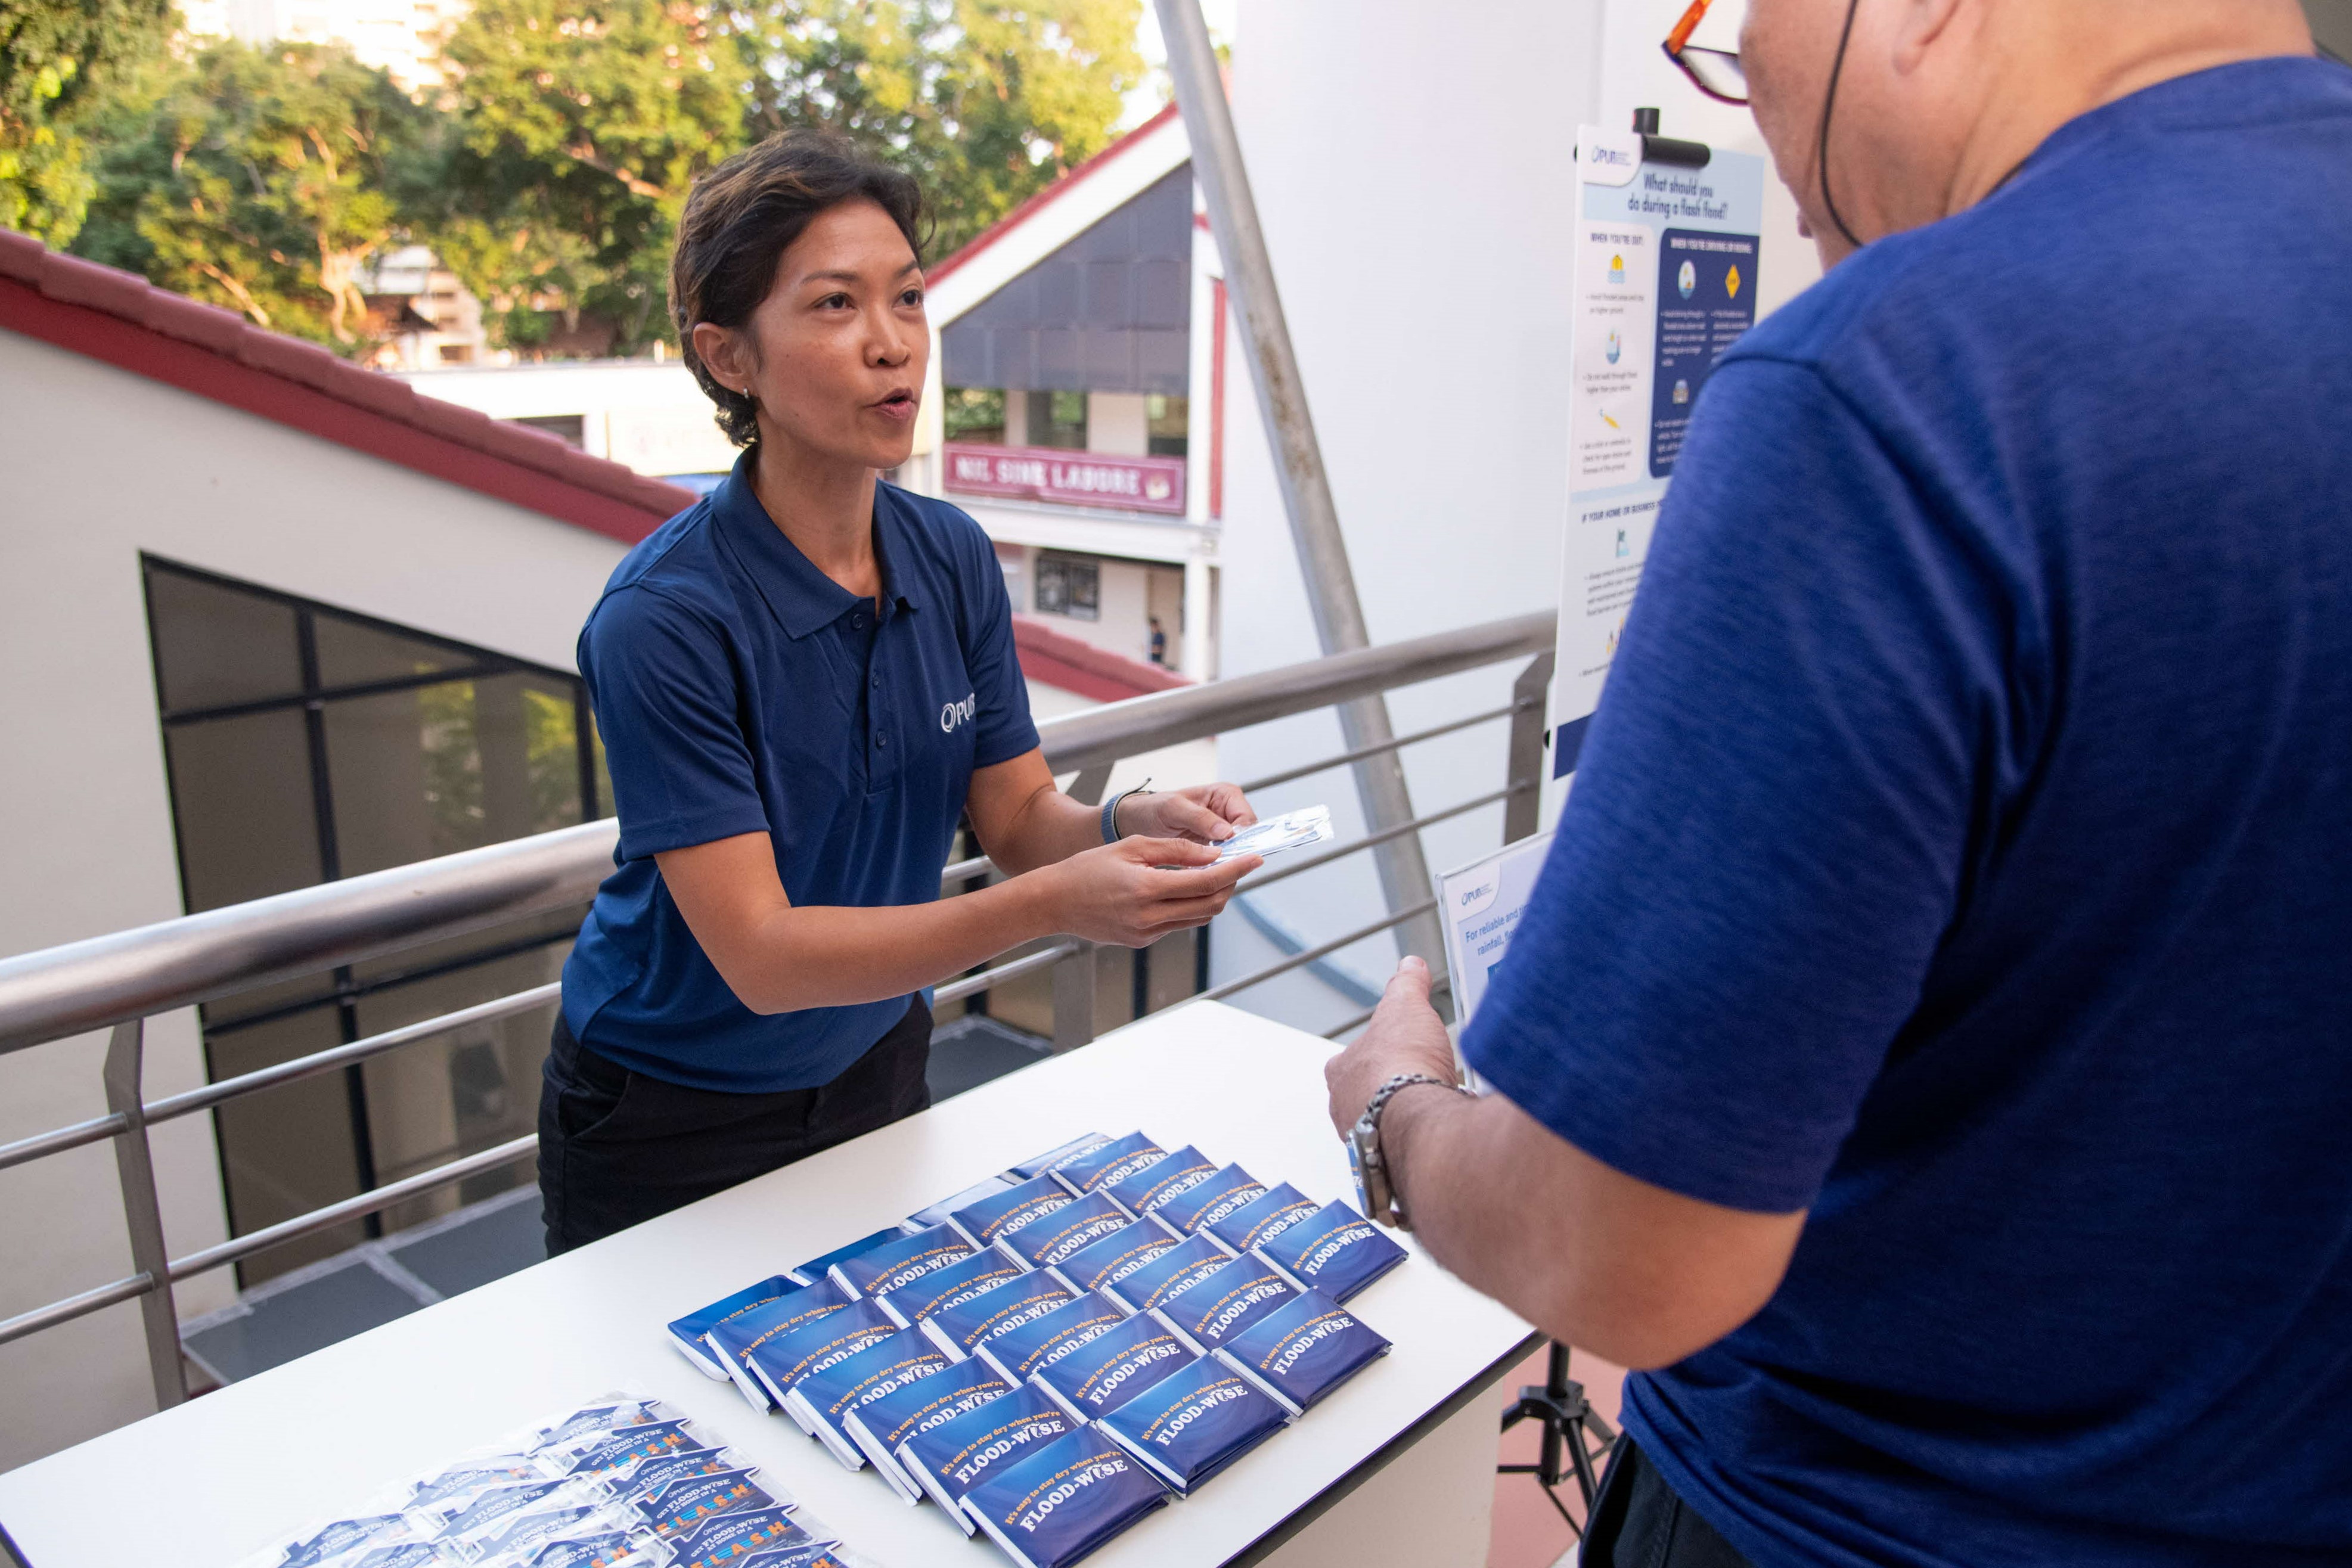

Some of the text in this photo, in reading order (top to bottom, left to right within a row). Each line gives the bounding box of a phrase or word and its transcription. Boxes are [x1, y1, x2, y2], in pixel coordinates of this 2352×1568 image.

[1628, 192, 1639, 210] do
[1643, 194, 1670, 219] during
[1673, 203, 1678, 215] a
[1680, 197, 1700, 217] flash
[1644, 172, 1713, 200] What should you
[1051, 464, 1141, 495] LABORE
[1589, 511, 1603, 521] YOUR
[1606, 507, 1621, 518] HOME
[1632, 501, 1655, 514] BUSINESS
[1466, 930, 1478, 943] For
[1479, 915, 1505, 936] reliable
[1506, 907, 1518, 923] and
[1045, 1219, 1127, 1265] FLOOD-WISE
[1305, 1227, 1375, 1275] FLOOD-WISE
[1208, 1283, 1286, 1339] FLOOD-WISE
[1260, 1359, 1270, 1370] It's
[1267, 1347, 1279, 1360] easy
[1283, 1333, 1295, 1343] stay
[1294, 1324, 1307, 1333] dry
[1305, 1314, 1329, 1326] when
[1273, 1317, 1354, 1374] FLOOD-WISE
[830, 1403, 842, 1414] It's
[840, 1391, 855, 1403] easy
[864, 1375, 879, 1385] stay
[880, 1368, 893, 1376] dry
[894, 1359, 916, 1369] when
[1076, 1387, 1087, 1398] It's
[1085, 1375, 1098, 1388] easy
[1103, 1359, 1117, 1369] stay
[1117, 1351, 1130, 1359] dry
[1130, 1342, 1150, 1352] when
[1090, 1343, 1180, 1405] FLOOD-WISE
[888, 1430, 901, 1442] It's
[899, 1418, 914, 1431] easy
[922, 1402, 938, 1413] stay
[939, 1395, 952, 1404] dry
[954, 1387, 976, 1396] when
[1141, 1430, 1153, 1440] It's
[1151, 1418, 1163, 1430] easy
[1169, 1402, 1183, 1412] stay
[1195, 1384, 1215, 1395] when
[1156, 1384, 1248, 1446] FLOOD-WISE
[592, 1456, 603, 1465] GET
[601, 1428, 663, 1460] FLOOD-WISE
[617, 1443, 635, 1454] HOME
[941, 1463, 954, 1475] It's
[952, 1450, 969, 1464] easy
[976, 1434, 992, 1445] stay
[993, 1426, 1007, 1435] dry
[1009, 1417, 1032, 1427] when
[954, 1420, 1065, 1484] FLOOD-WISE
[629, 1457, 703, 1495] GET FLOOD-WISE
[657, 1508, 669, 1519] GET
[666, 1479, 731, 1510] FLOOD-WISE
[1005, 1511, 1019, 1525] It's
[1016, 1497, 1032, 1512] easy
[1039, 1478, 1055, 1491] stay
[1055, 1470, 1070, 1479] dry
[1070, 1458, 1093, 1470] when
[1019, 1460, 1128, 1532] FLOOD-WISE
[474, 1490, 544, 1520] FLOOD-WISE
[683, 1496, 701, 1507] HOME
[691, 1547, 704, 1557] GET
[702, 1516, 768, 1548] FLOOD-WISE
[718, 1533, 736, 1545] HOME
